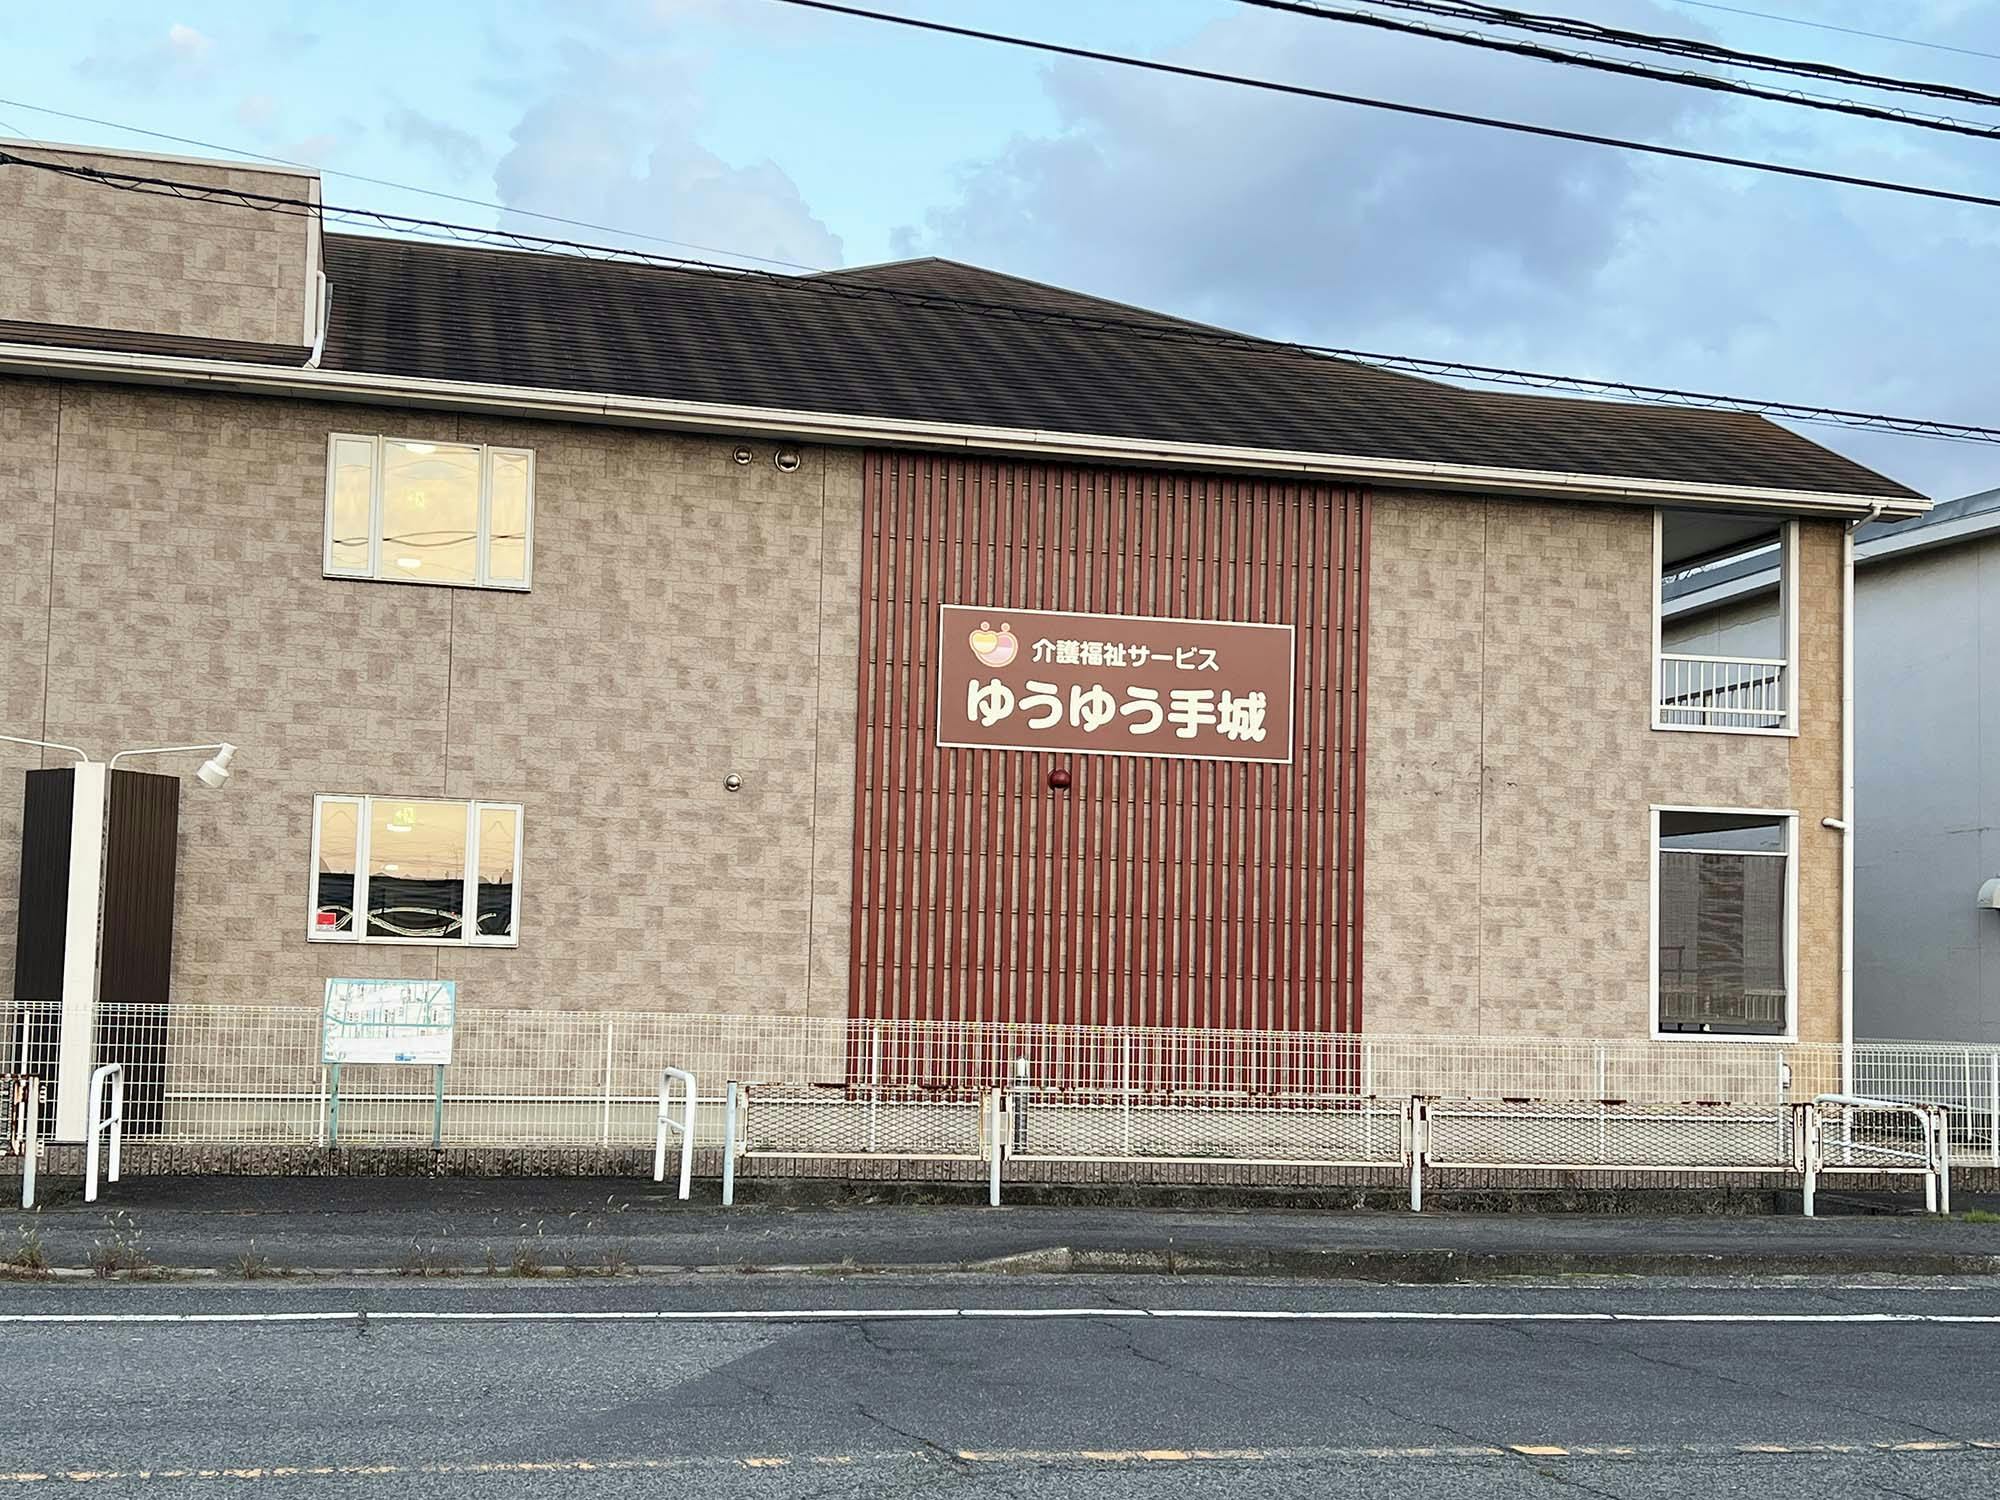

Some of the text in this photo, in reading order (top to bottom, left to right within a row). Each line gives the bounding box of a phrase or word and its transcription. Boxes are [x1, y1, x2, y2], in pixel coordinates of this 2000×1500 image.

[1031, 638, 1220, 672] 介護福祉サービス
[967, 678, 1267, 743] ゆうゆう手城
